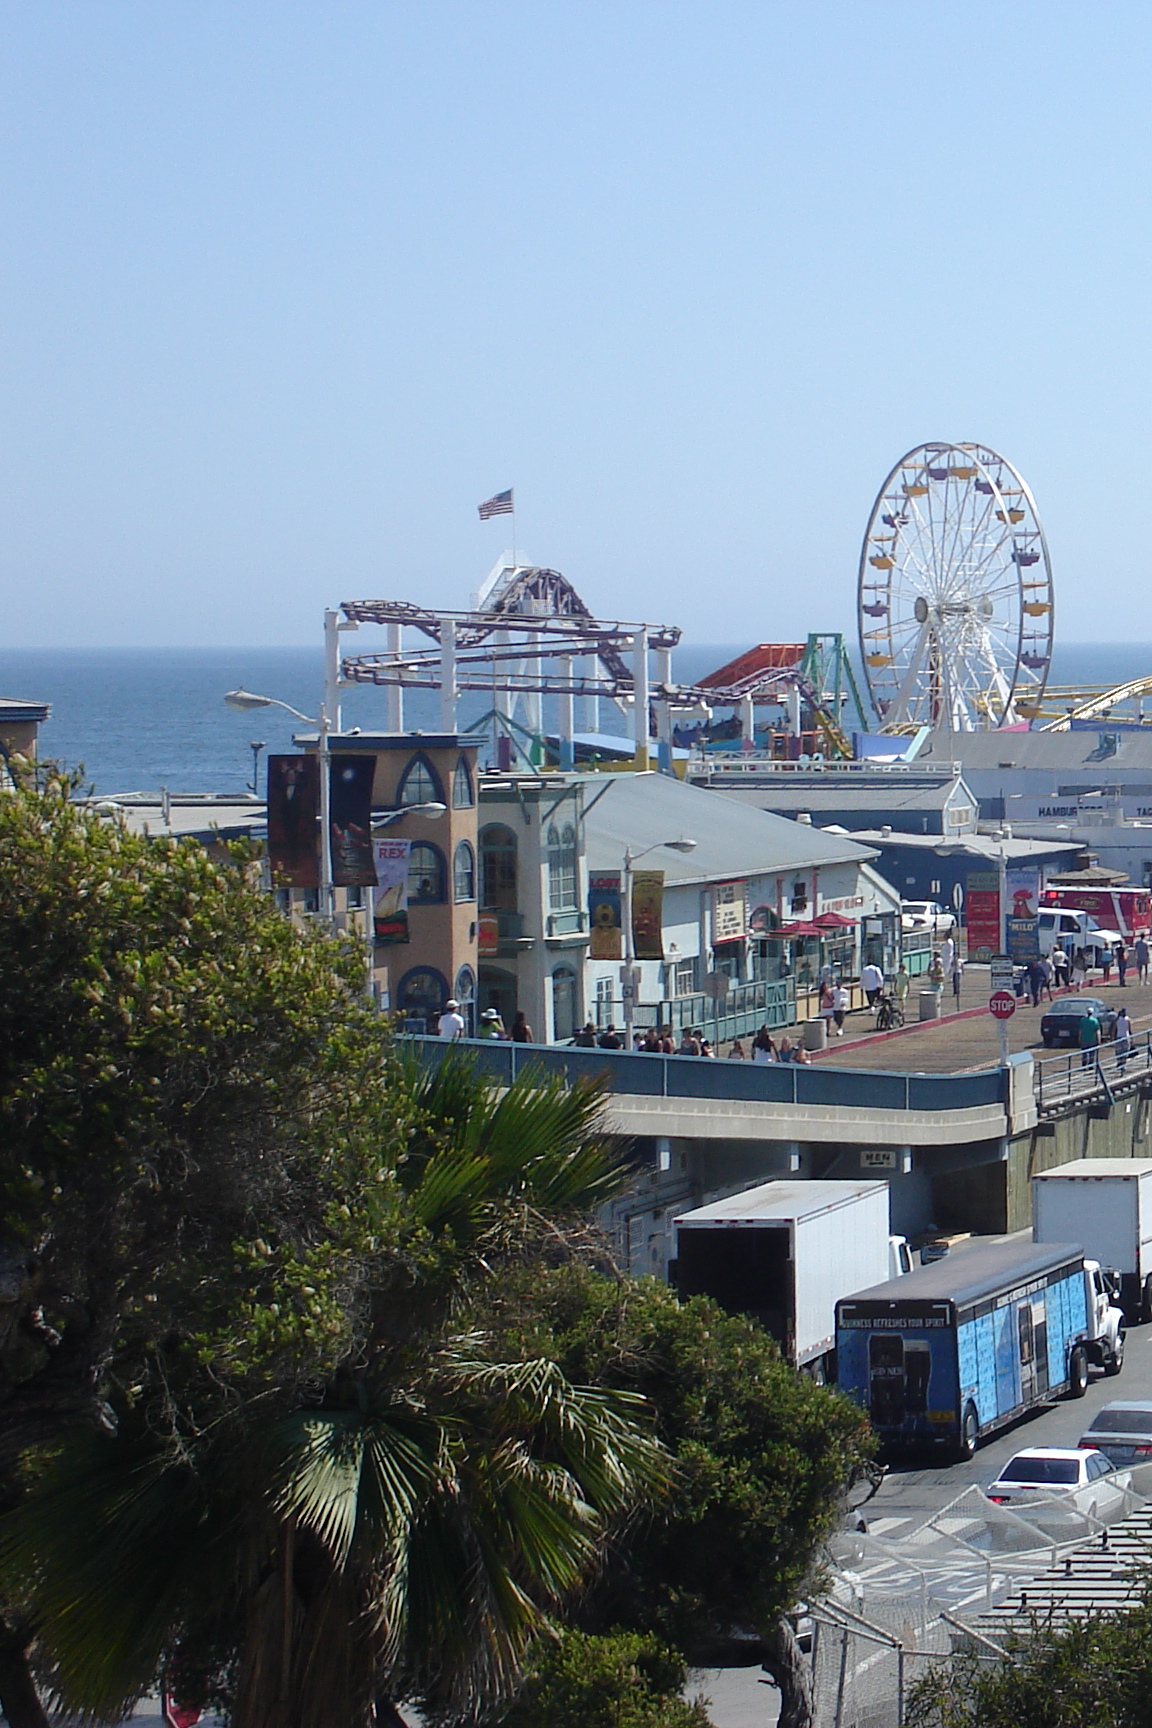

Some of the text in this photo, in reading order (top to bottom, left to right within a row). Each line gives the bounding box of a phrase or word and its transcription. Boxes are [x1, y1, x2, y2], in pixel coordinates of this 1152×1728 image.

[1038, 805, 1103, 817] HAMBUR
[378, 848, 406, 859] REX
[990, 1000, 1015, 1011] STOP
[873, 1318, 907, 1328] REFRESHES
[925, 1318, 945, 1328] SPIRIT
